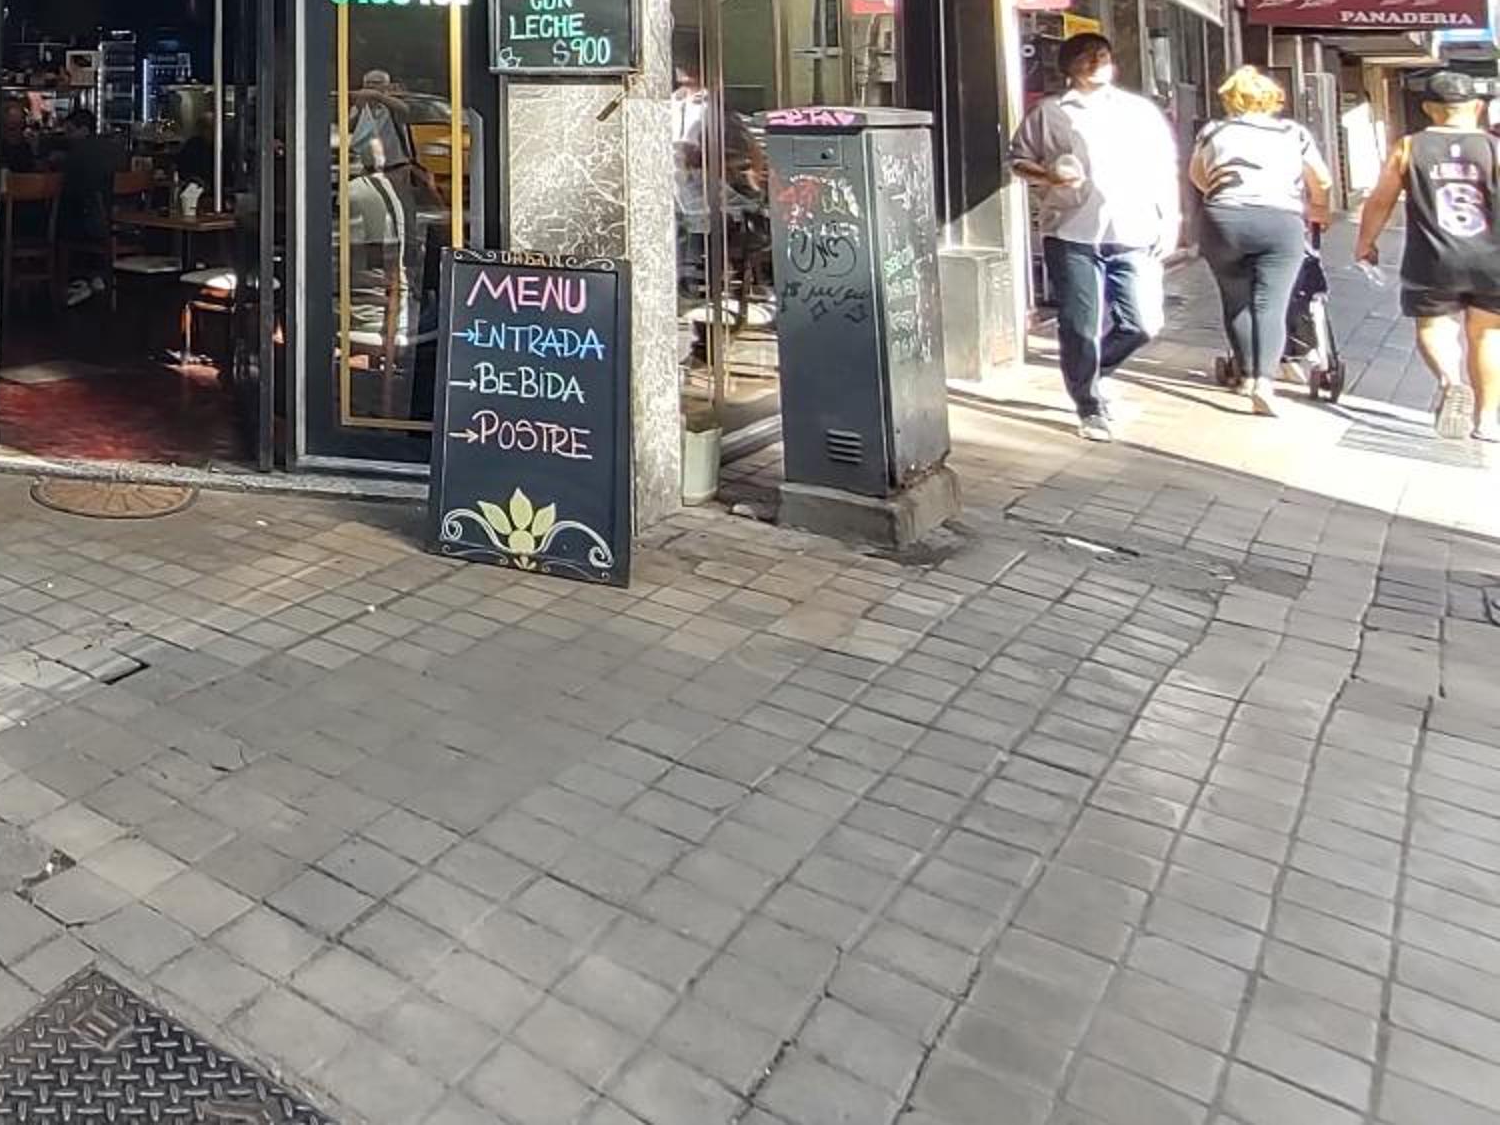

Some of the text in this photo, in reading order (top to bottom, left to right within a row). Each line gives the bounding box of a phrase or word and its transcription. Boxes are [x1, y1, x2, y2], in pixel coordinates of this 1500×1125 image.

[509, 13, 585, 40] LECHE
[1340, 10, 1475, 25] PANADERIA
[466, 270, 588, 314] MENU
[473, 319, 605, 360] ENTRADA
[472, 410, 593, 460] POSTRE
